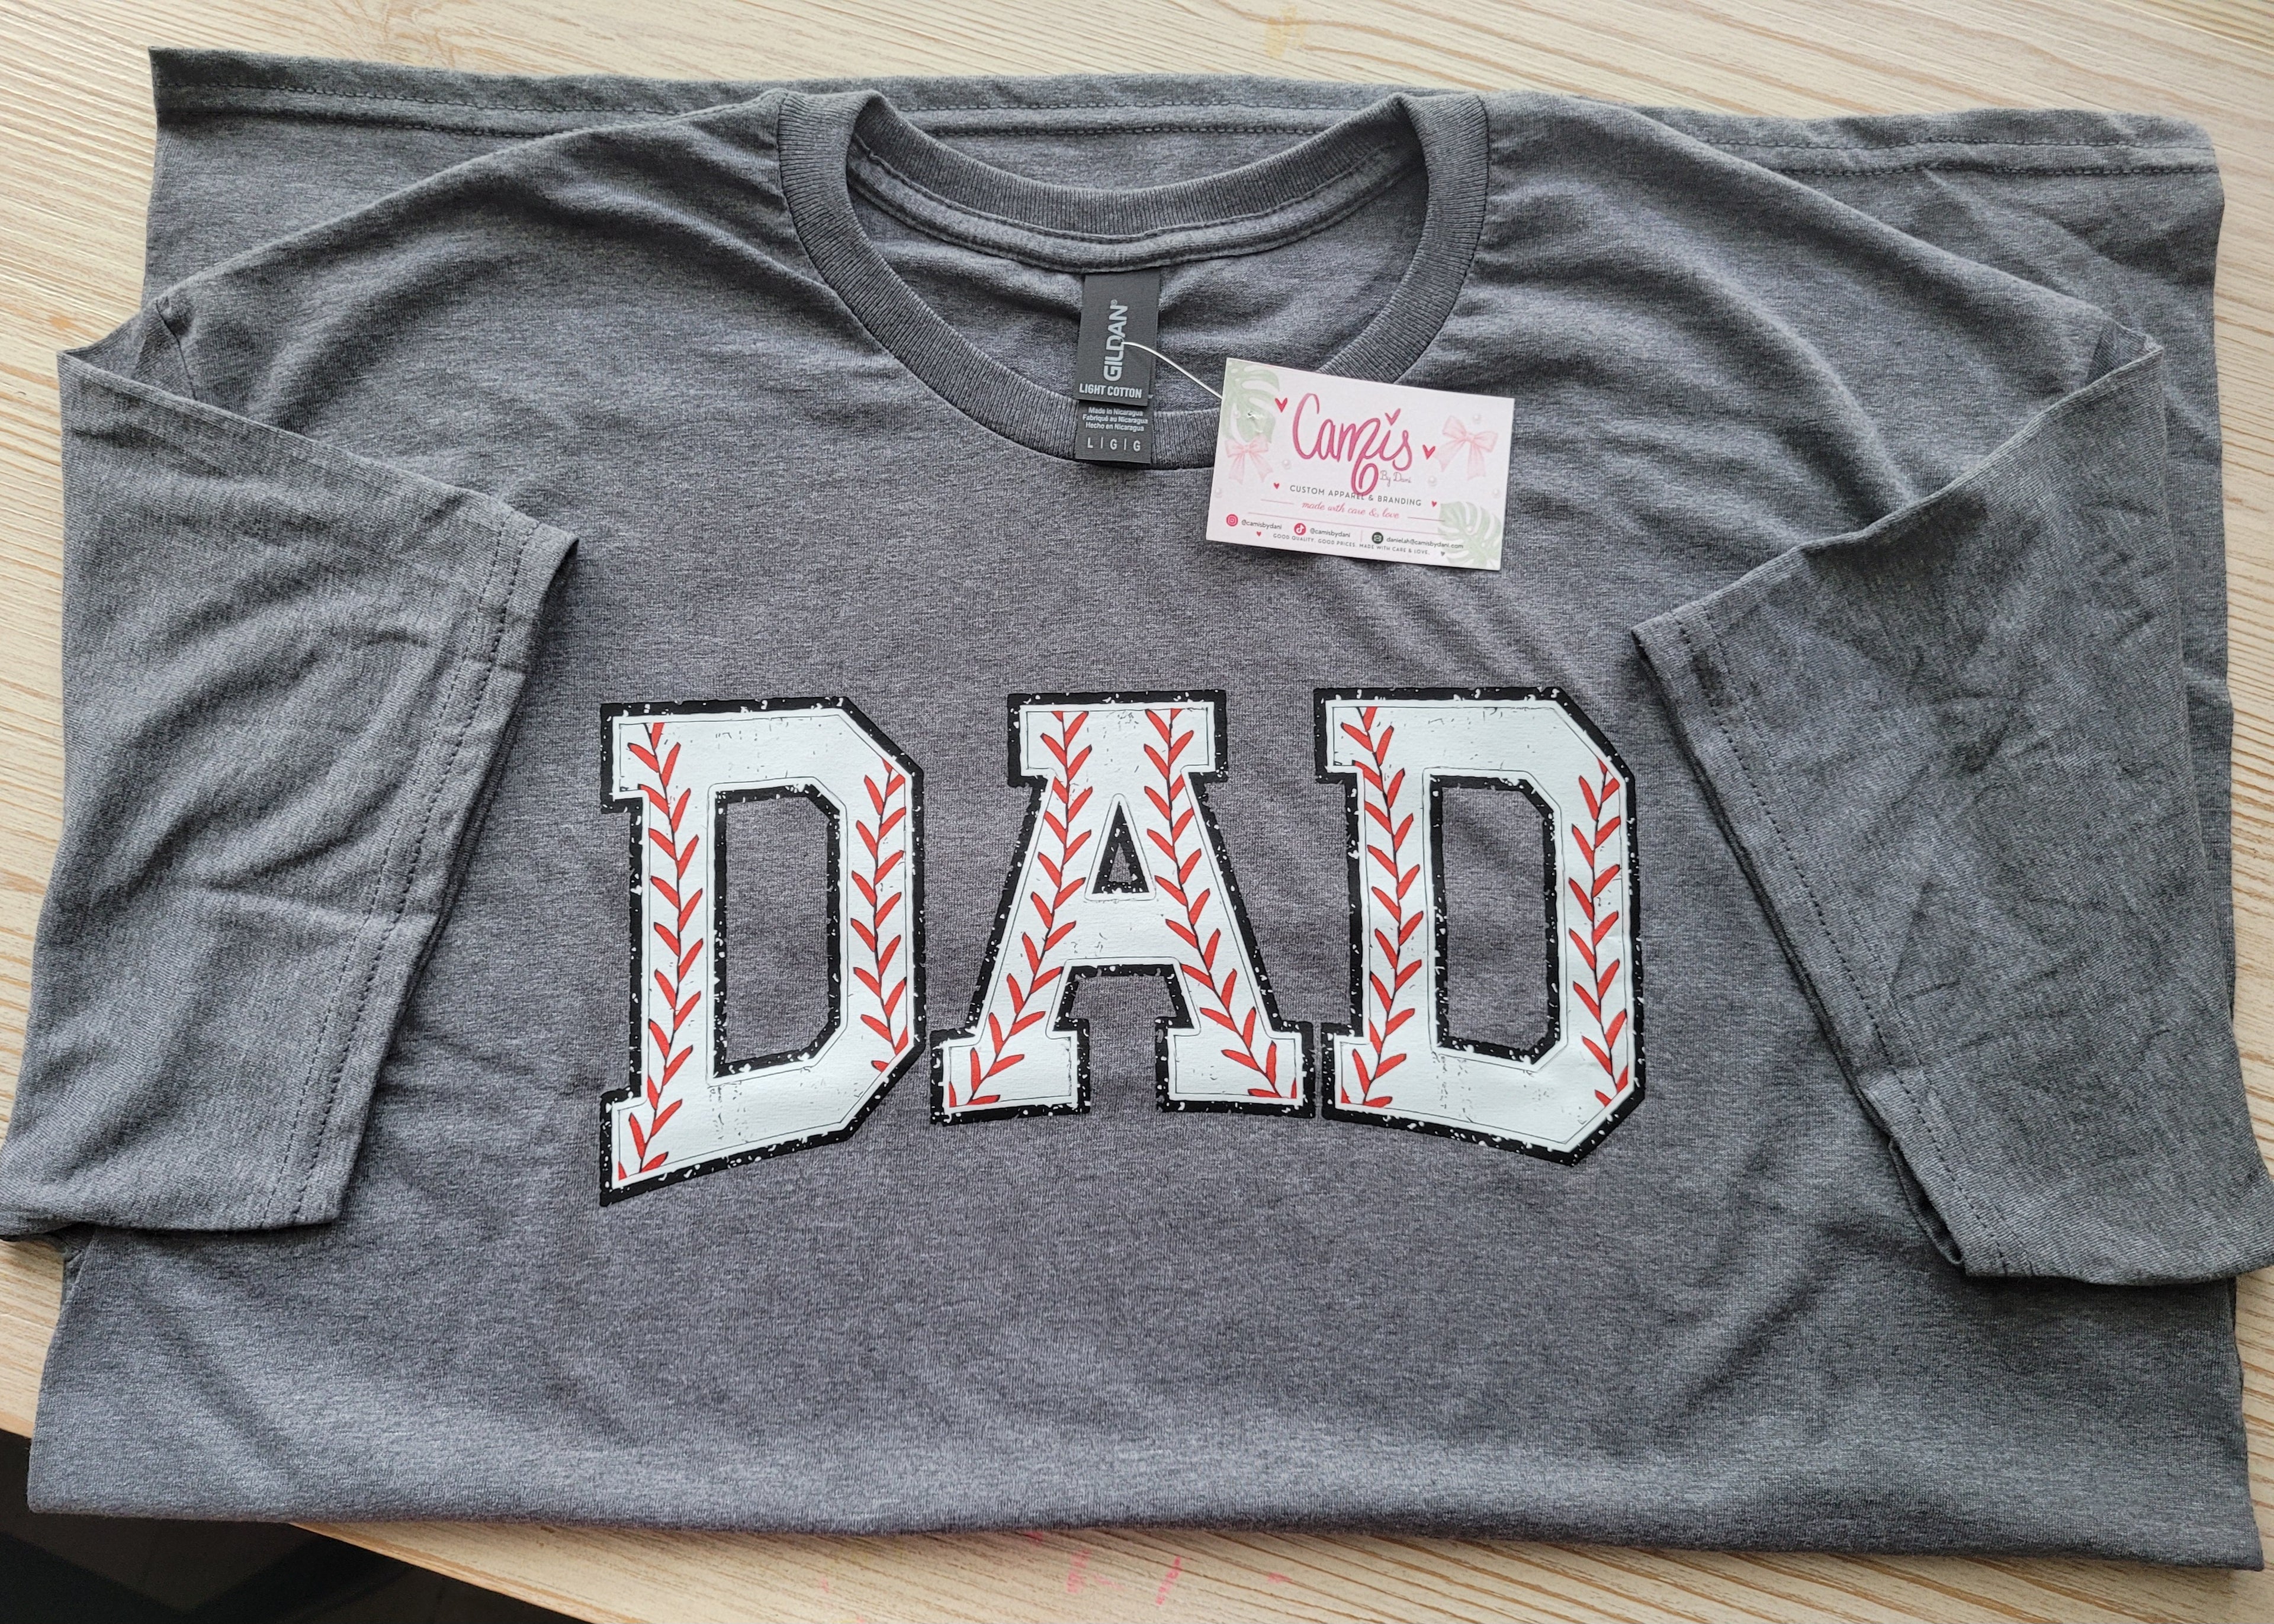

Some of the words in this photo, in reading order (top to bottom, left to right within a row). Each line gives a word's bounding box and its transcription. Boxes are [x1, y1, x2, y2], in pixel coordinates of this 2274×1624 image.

[1079, 383, 1107, 395] LIGHT
[1107, 386, 1142, 398] COTTON
[1113, 408, 1144, 417] Nicaragua
[1083, 414, 1109, 422] Fabriqué
[1118, 416, 1148, 425] Nicaragua
[1114, 424, 1144, 432] Nicaragua
[1087, 437, 1093, 448] L
[1380, 470, 1391, 487] By
[1290, 485, 1325, 496] CUSTOM
[1328, 490, 1365, 500] APPAREL
[1377, 496, 1422, 506] BRANDING
[1302, 502, 1325, 510] made
[1328, 503, 1345, 513] with
[1369, 508, 1379, 517] &
[1382, 508, 1399, 519] love
[1241, 519, 1282, 530] @camisbydani
[1309, 528, 1351, 538] @camisbydani
[599, 687, 1645, 1206] DAD
